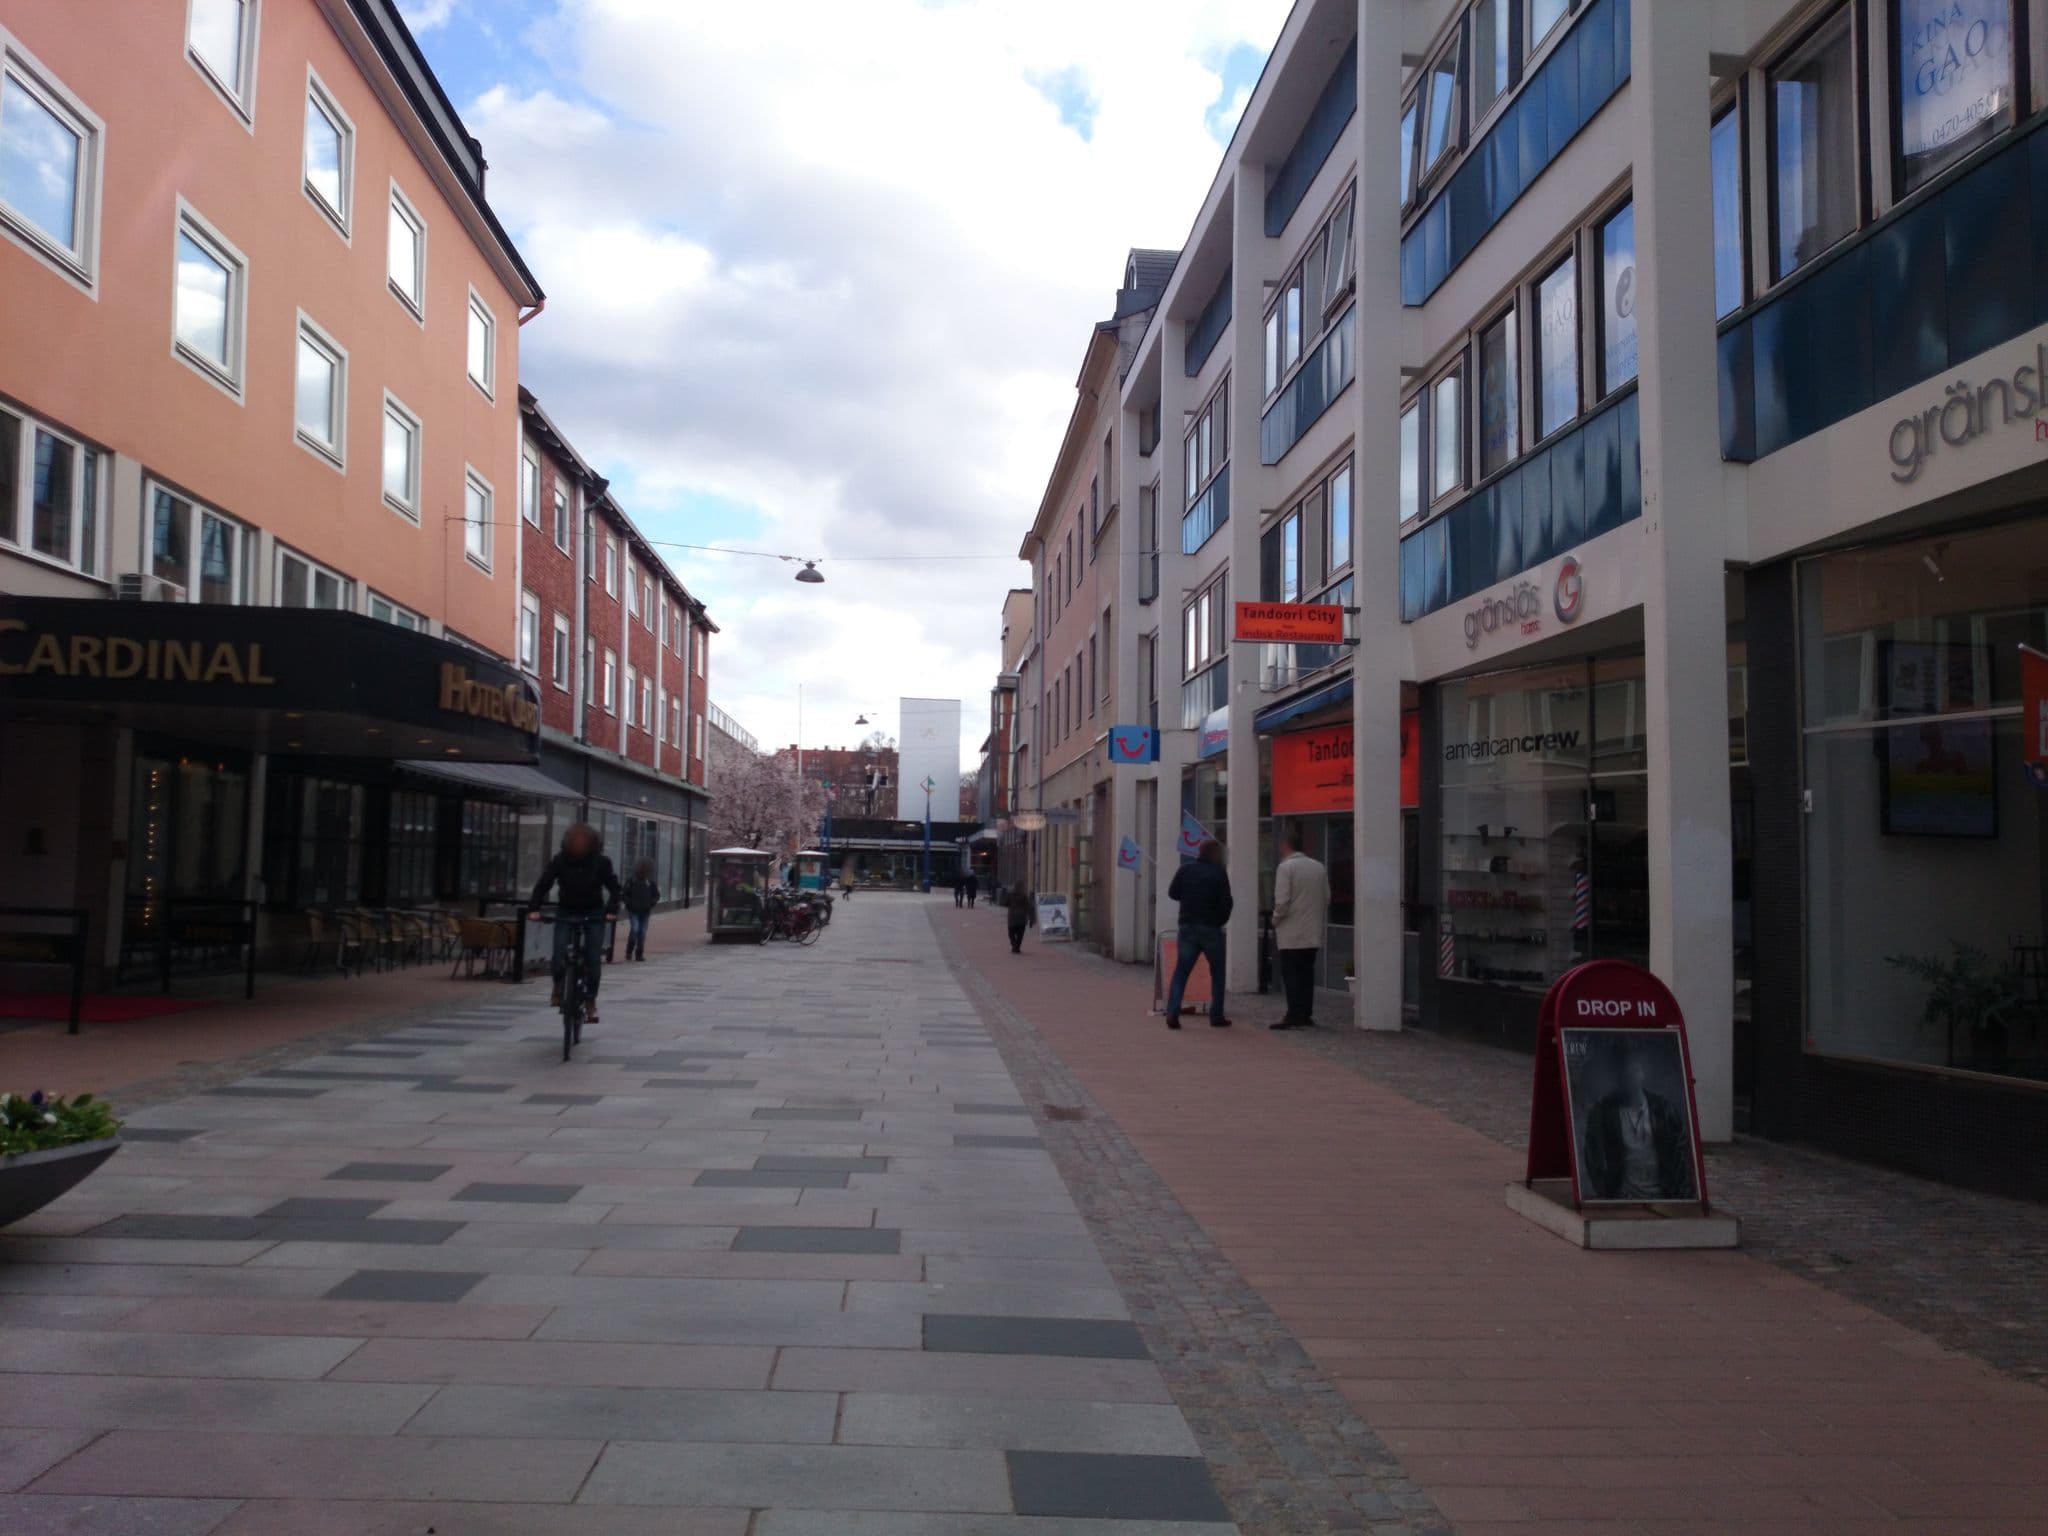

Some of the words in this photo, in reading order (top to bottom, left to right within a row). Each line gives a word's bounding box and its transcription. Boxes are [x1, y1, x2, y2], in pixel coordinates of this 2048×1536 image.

[1915, 19, 1988, 96] GAO
[1242, 607, 1303, 621] Tandoori
[1308, 609, 1336, 624] City
[1464, 581, 1542, 648] gränslös
[0, 618, 276, 686] CARDINAL
[1576, 999, 1632, 1016] DROP
[1637, 1001, 1657, 1017] IN
